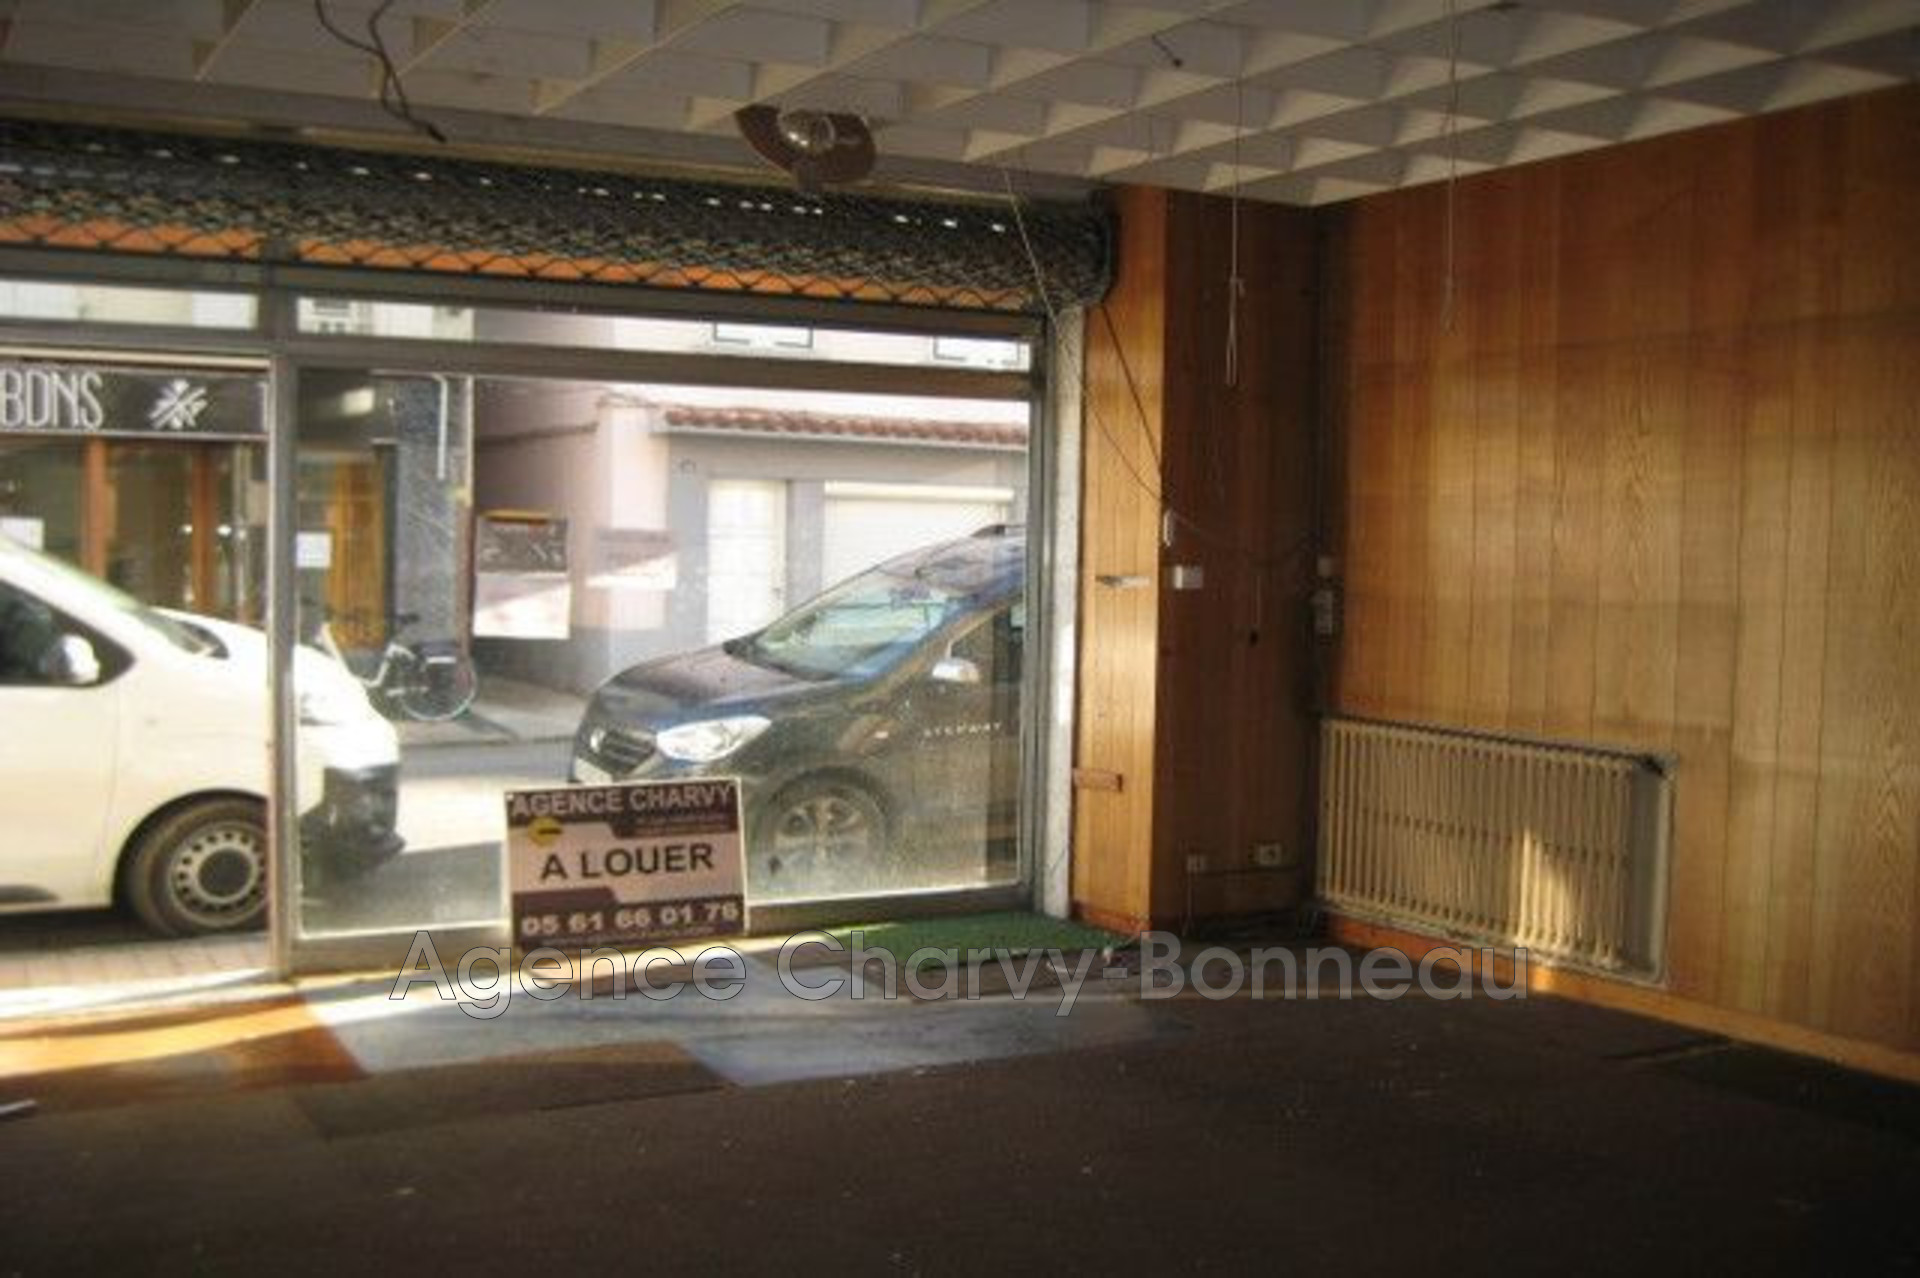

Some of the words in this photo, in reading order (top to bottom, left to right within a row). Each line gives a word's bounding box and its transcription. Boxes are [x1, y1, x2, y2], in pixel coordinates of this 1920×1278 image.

[511, 789, 624, 816] AGENCE
[629, 784, 731, 811] CHARVY
[540, 853, 568, 880] A
[581, 843, 715, 878] LOUER
[522, 914, 560, 936] 05
[568, 911, 604, 934] 61
[660, 904, 693, 926] 01
